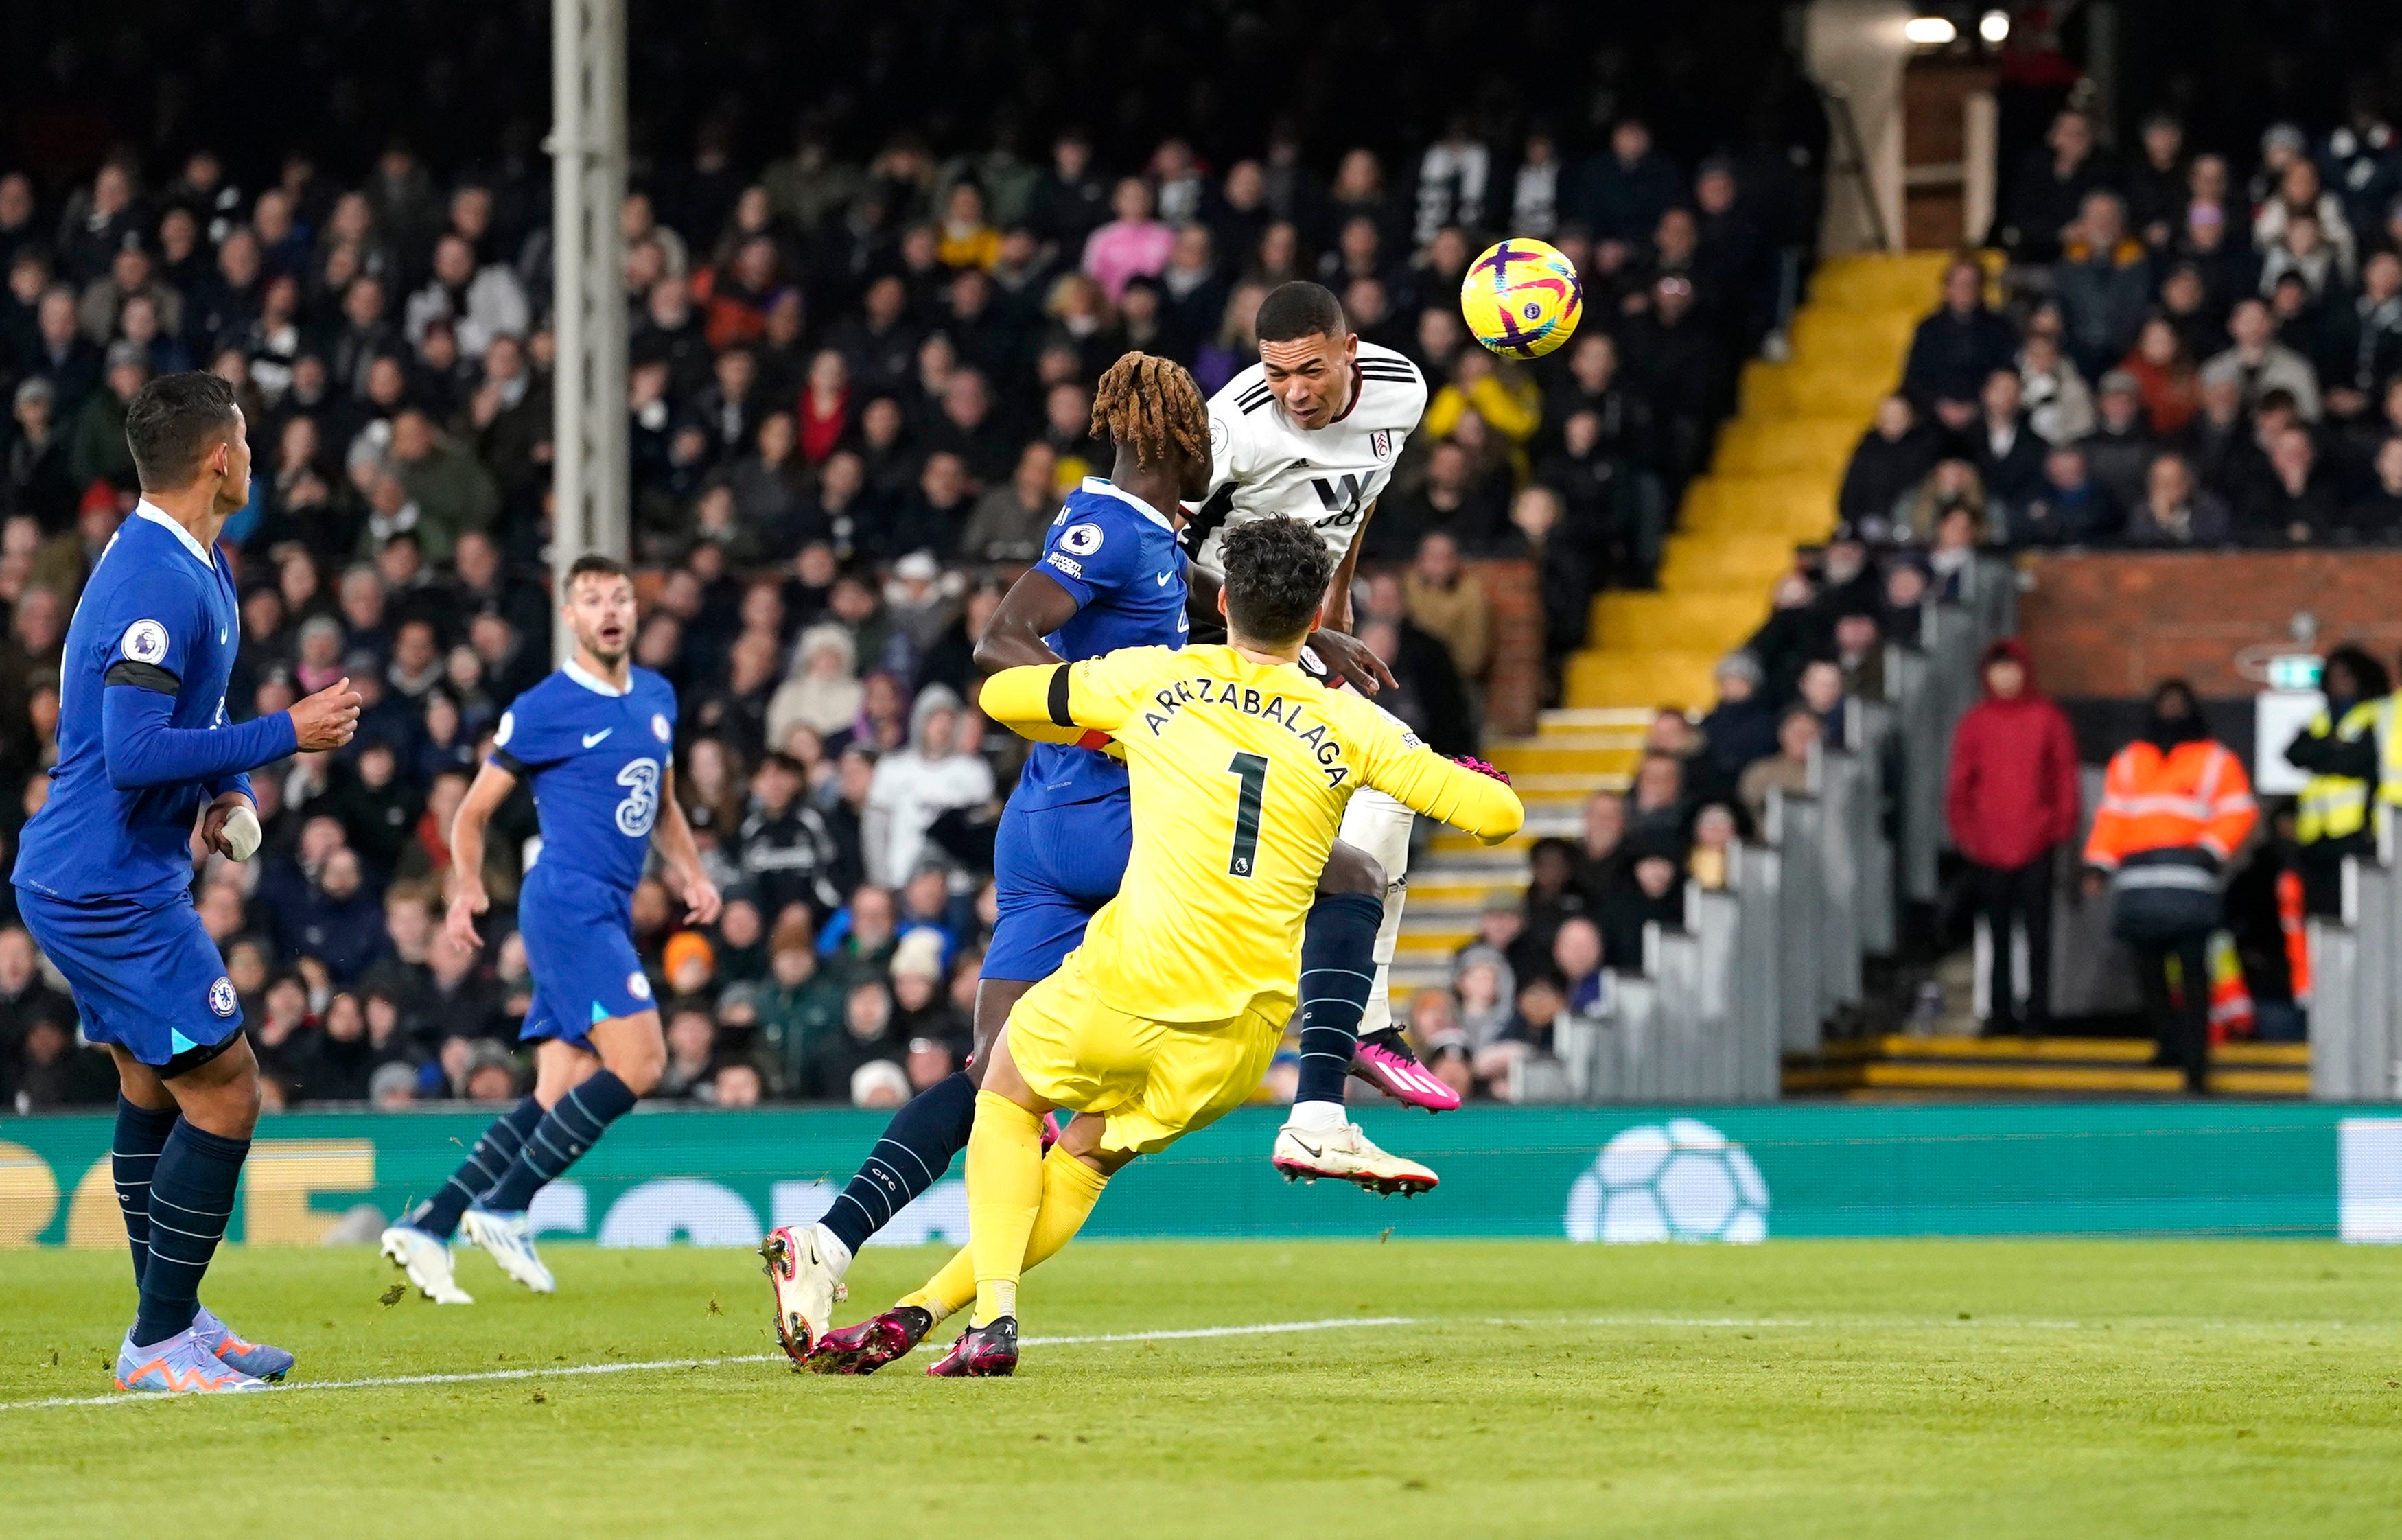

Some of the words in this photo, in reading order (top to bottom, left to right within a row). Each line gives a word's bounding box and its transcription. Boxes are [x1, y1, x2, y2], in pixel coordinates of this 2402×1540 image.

[1377, 433, 1388, 456] FFC
[1058, 555, 1082, 572] room
[1305, 651, 1321, 668] FFC
[615, 756, 660, 838] 3
[1228, 751, 1269, 878] 1
[872, 1167, 896, 1191] CFC
